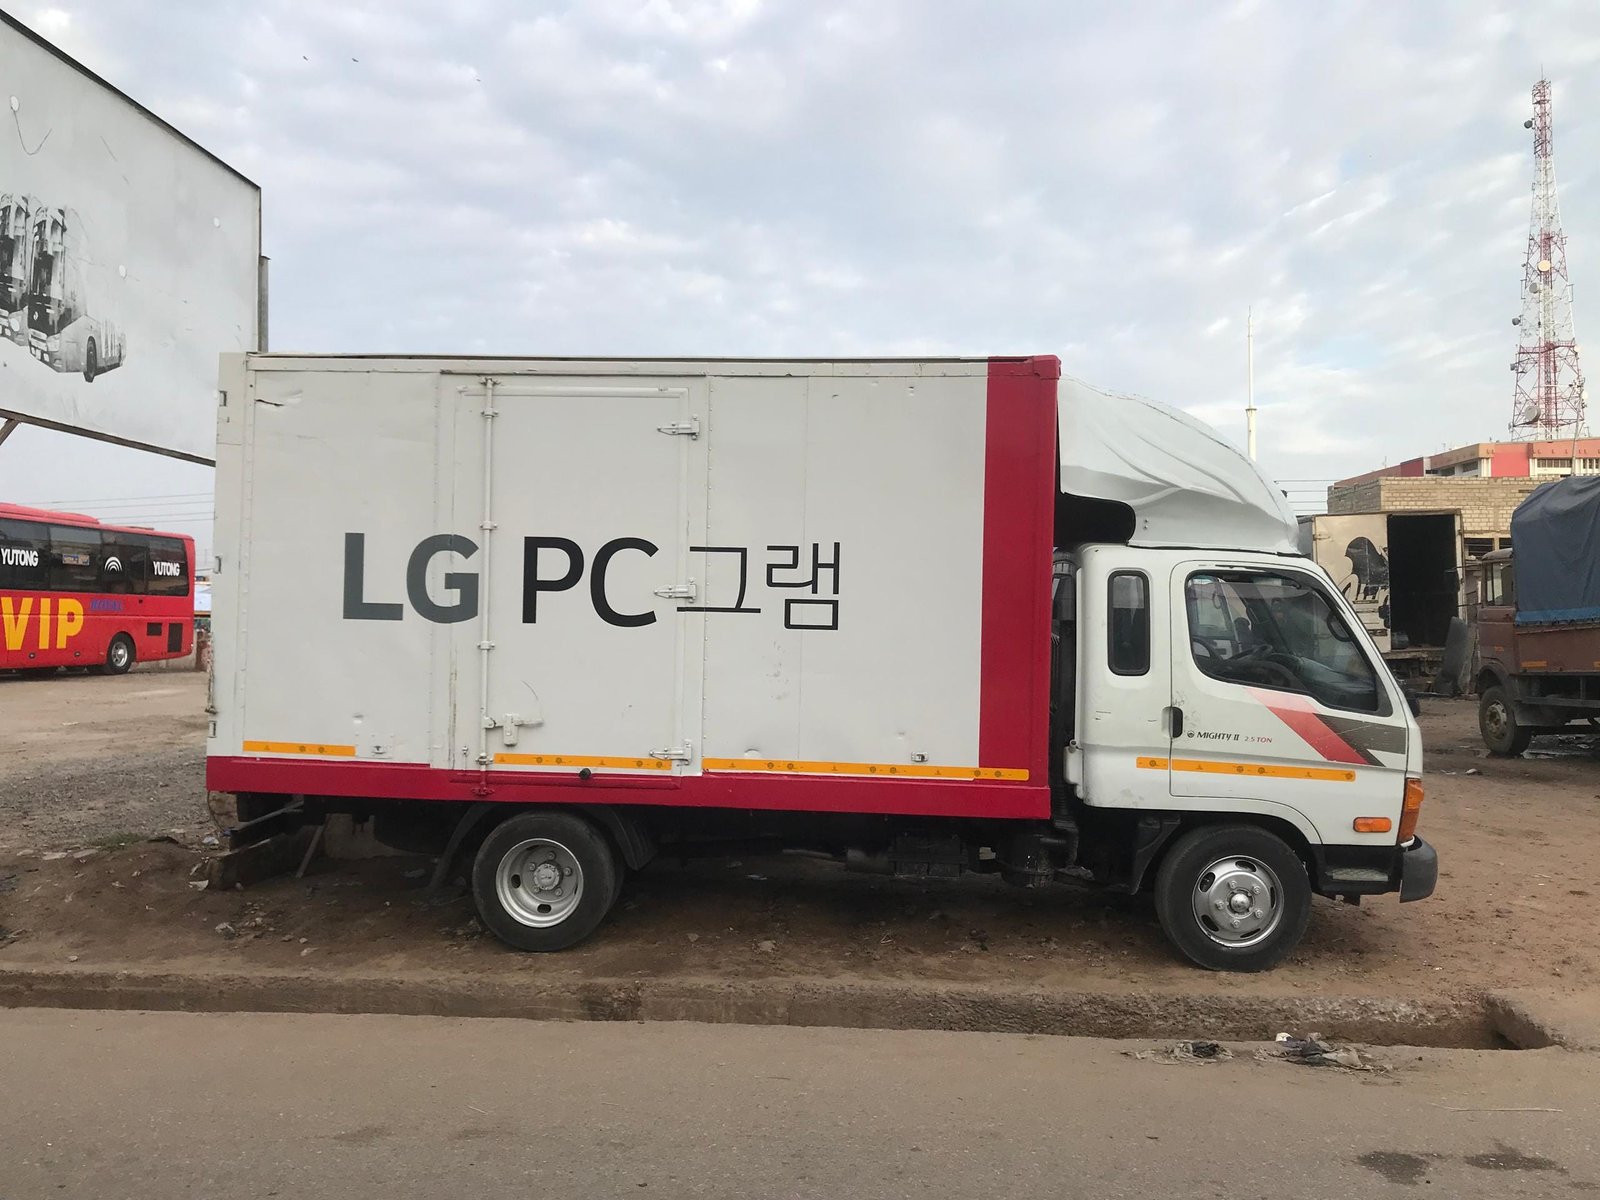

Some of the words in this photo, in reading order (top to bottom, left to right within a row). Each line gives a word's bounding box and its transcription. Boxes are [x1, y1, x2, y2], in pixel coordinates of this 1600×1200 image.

[1, 548, 39, 567] YUTONG
[153, 561, 180, 576] YUTONG
[343, 532, 479, 624] LG
[1, 596, 84, 650] VIP
[1197, 731, 1232, 741] MIGHTY
